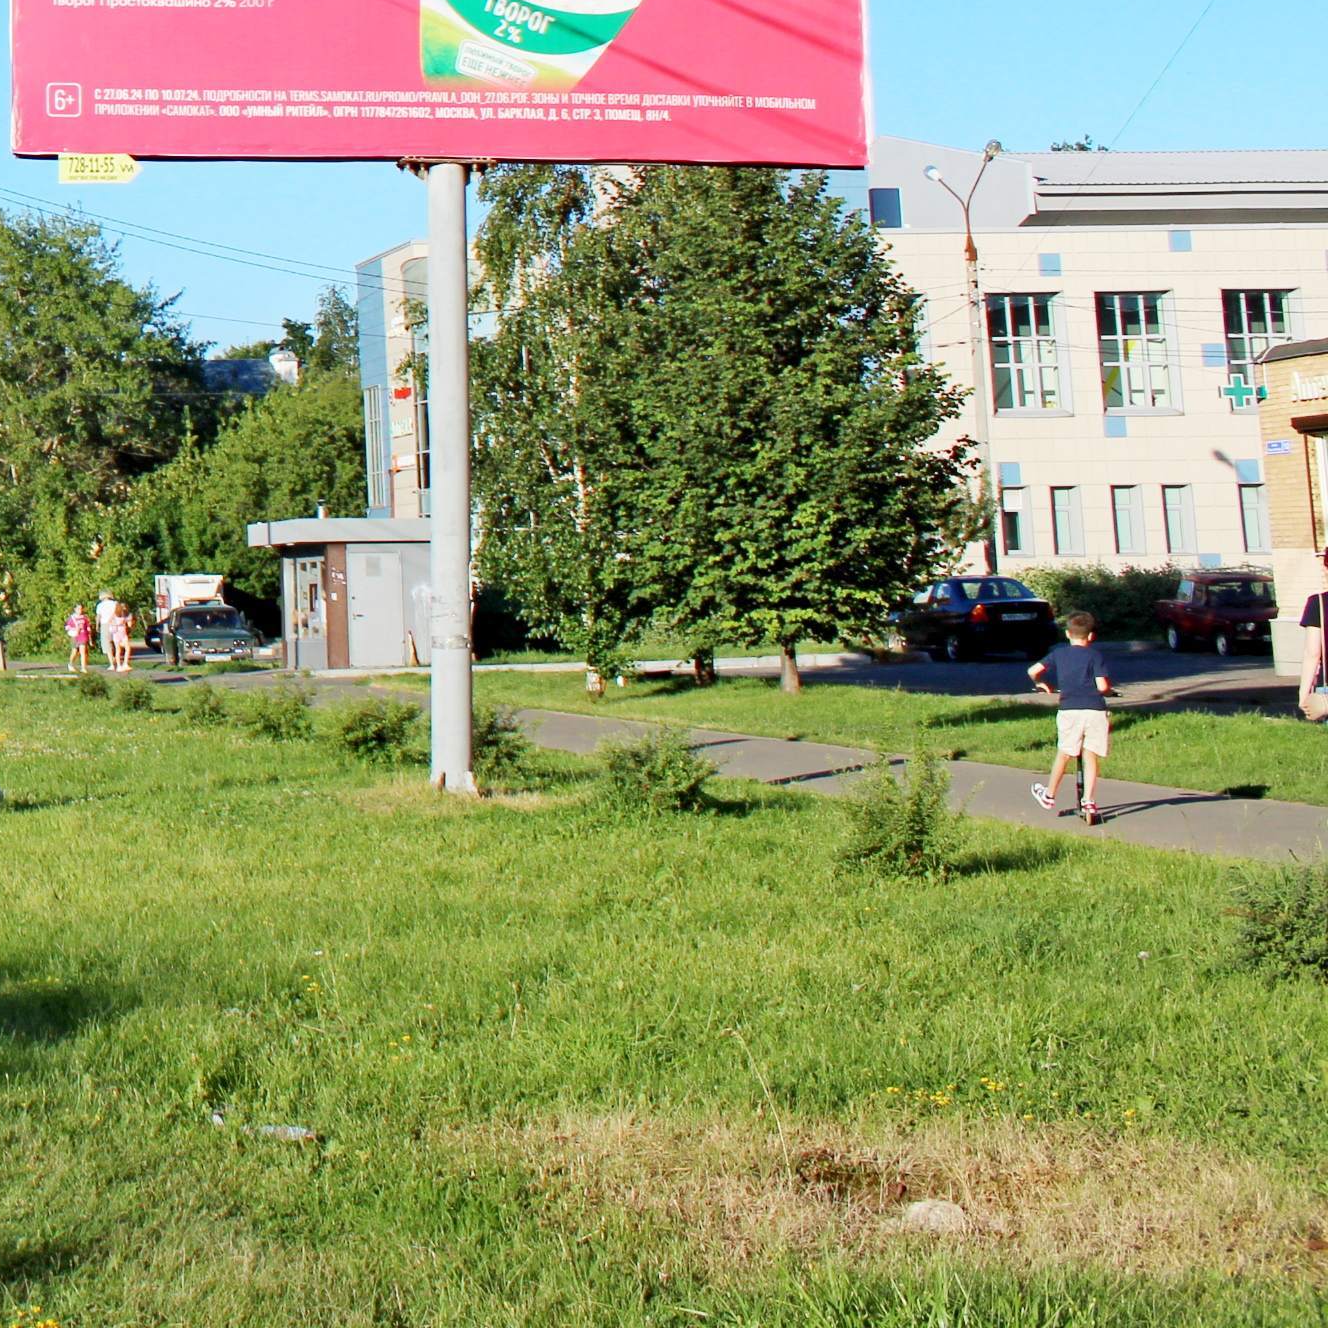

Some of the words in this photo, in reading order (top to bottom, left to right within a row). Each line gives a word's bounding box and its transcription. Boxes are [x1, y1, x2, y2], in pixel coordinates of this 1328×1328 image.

[54, 89, 75, 111] 6+
[103, 88, 143, 101] 27.06.24
[145, 89, 160, 101] ПО
[203, 89, 272, 103] ПОДРОБНОСТИ
[273, 90, 287, 102] НА
[531, 92, 560, 104] ЗОНЫ
[571, 92, 607, 105] ТОЧНОЕ
[608, 93, 641, 105] ВРЕМЯ
[642, 94, 691, 107] ДОСТАВКИ
[693, 94, 744, 108] УТОЧНЯЙТЕ
[745, 96, 753, 108] В
[754, 97, 816, 110] МОБИЛЬНОМ
[94, 103, 160, 116] ПРИЛОЖЕНИИ
[219, 105, 241, 117] ООО
[333, 105, 358, 118] ОГРН
[68, 157, 115, 173] 728-11-55
